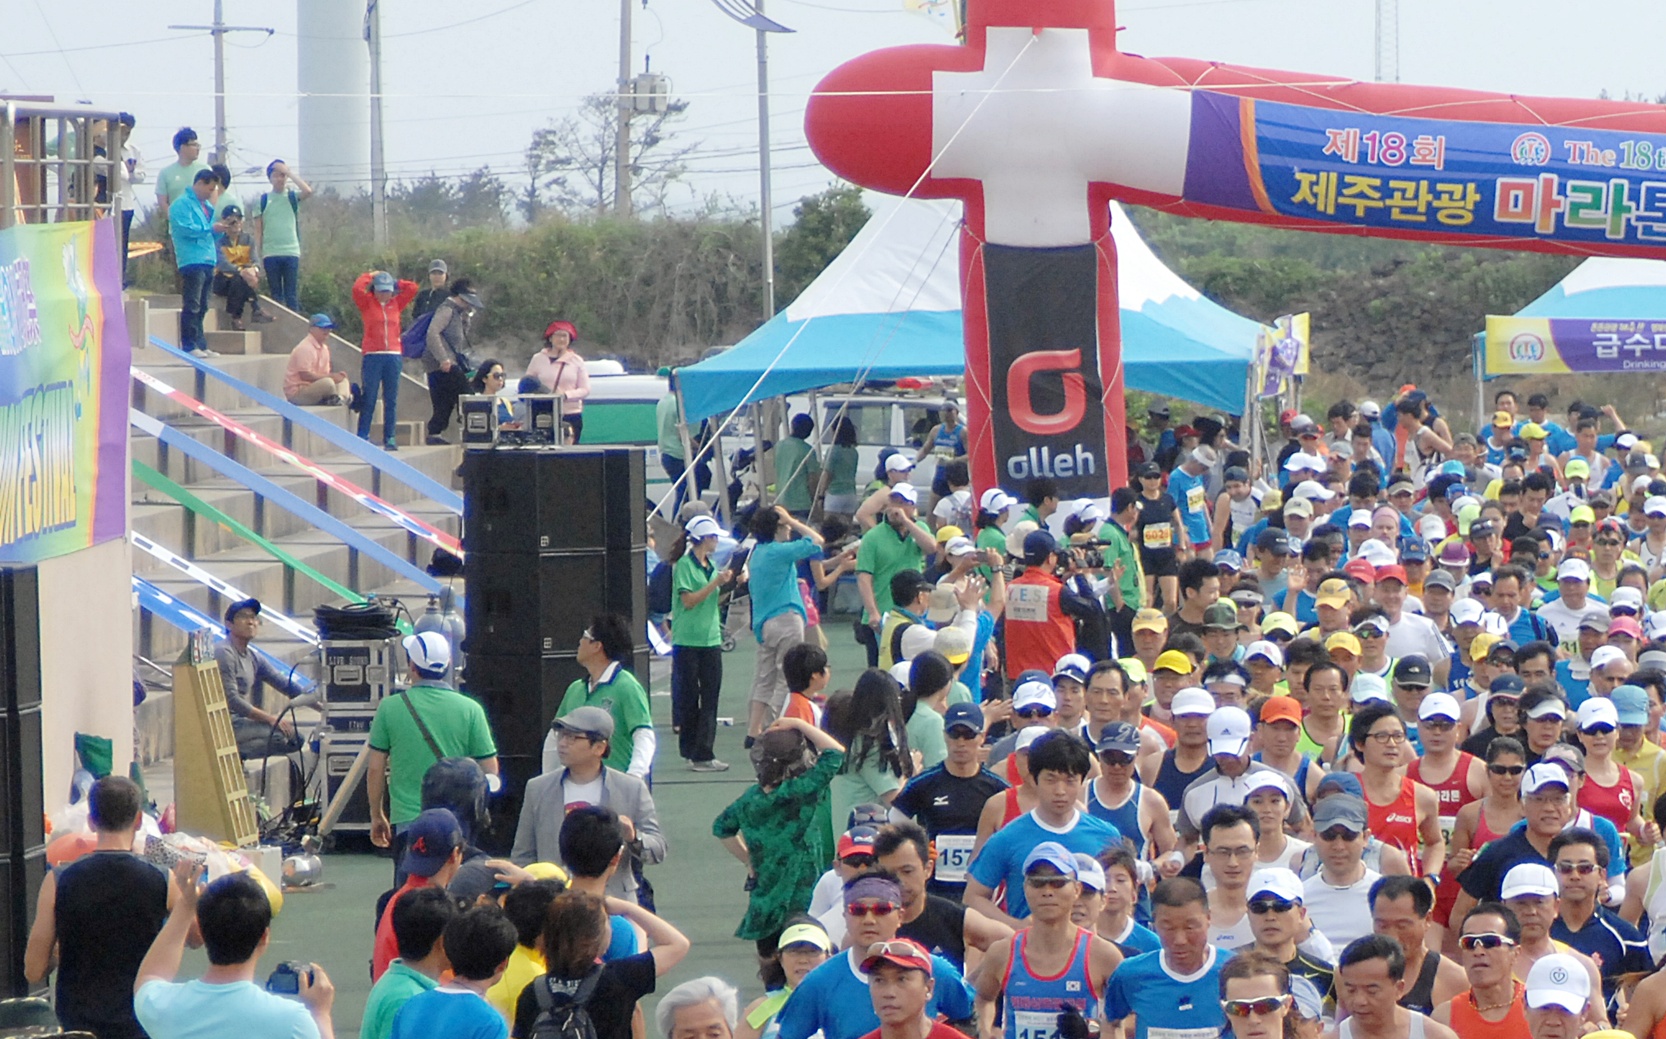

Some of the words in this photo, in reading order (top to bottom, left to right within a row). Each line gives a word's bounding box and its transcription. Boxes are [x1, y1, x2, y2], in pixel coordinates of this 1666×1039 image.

[1322, 127, 1446, 170] 제18회
[1564, 138, 1617, 168] The
[1292, 171, 1481, 226] 제주관광
[1007, 444, 1096, 480] olleh
[939, 848, 974, 868] 157
